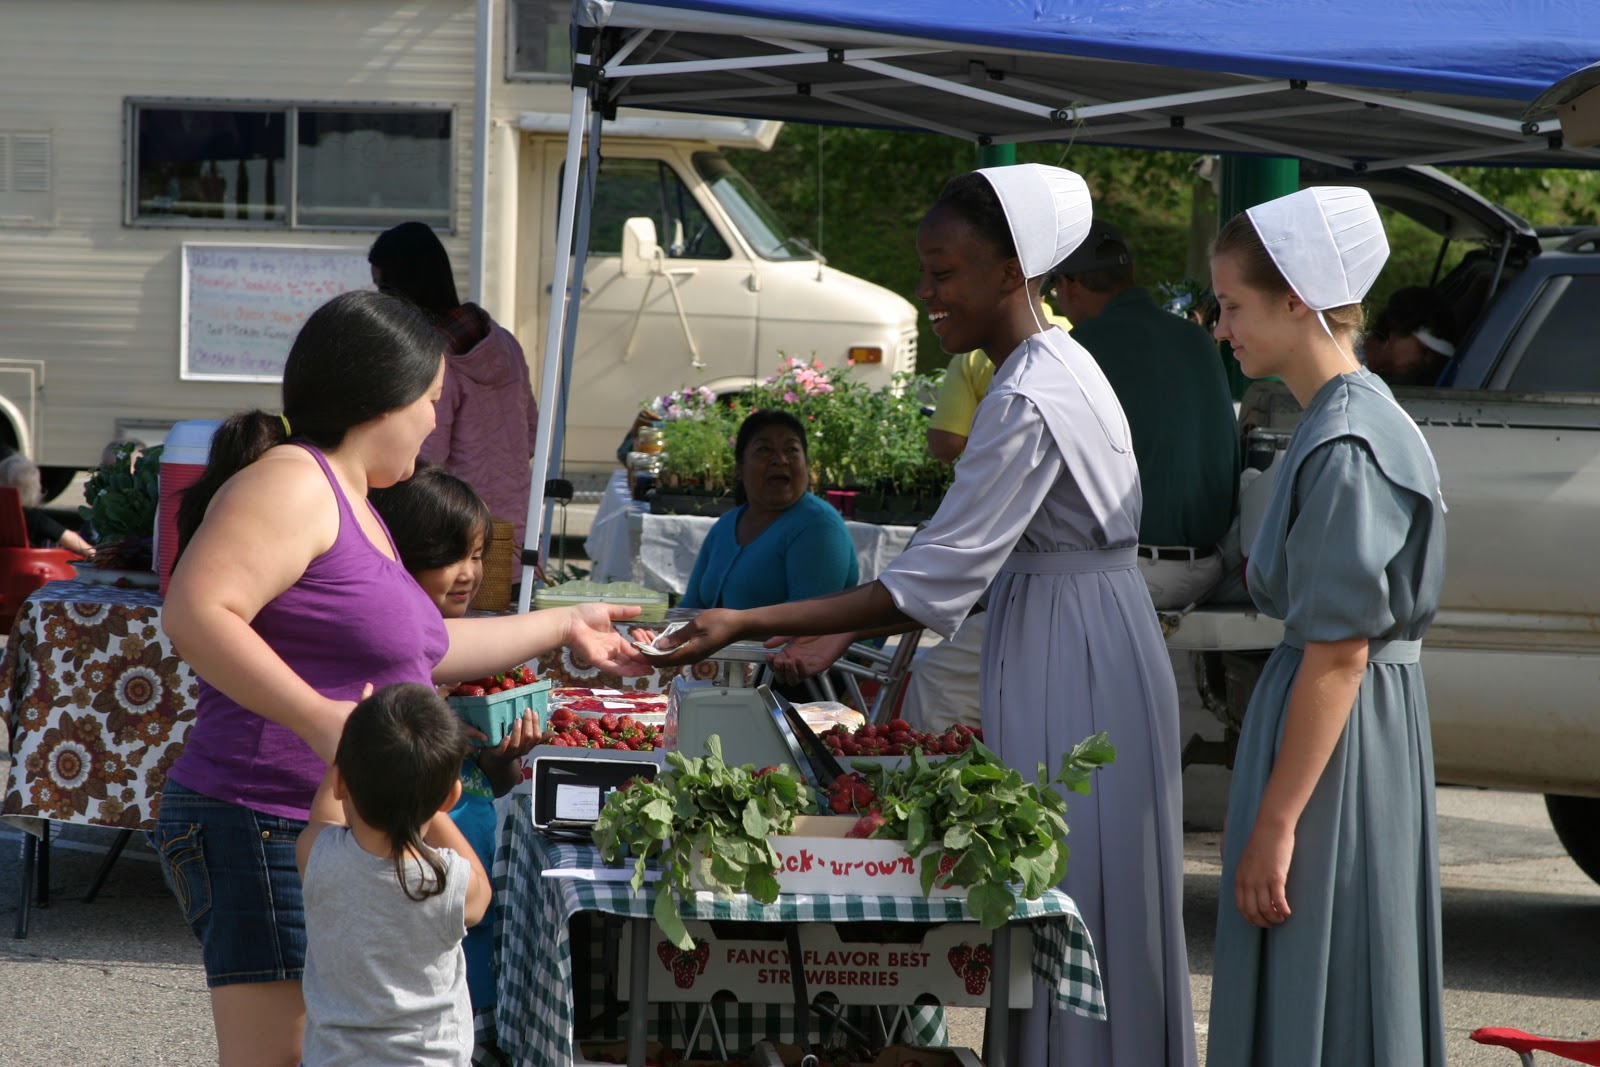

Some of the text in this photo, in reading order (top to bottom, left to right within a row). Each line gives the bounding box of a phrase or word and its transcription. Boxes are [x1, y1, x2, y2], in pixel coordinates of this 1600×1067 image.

[769, 848, 916, 877] ck-ur-own
[726, 948, 931, 968] FANCY FLAVOR BEST
[757, 968, 899, 986] STRWBERRIES
